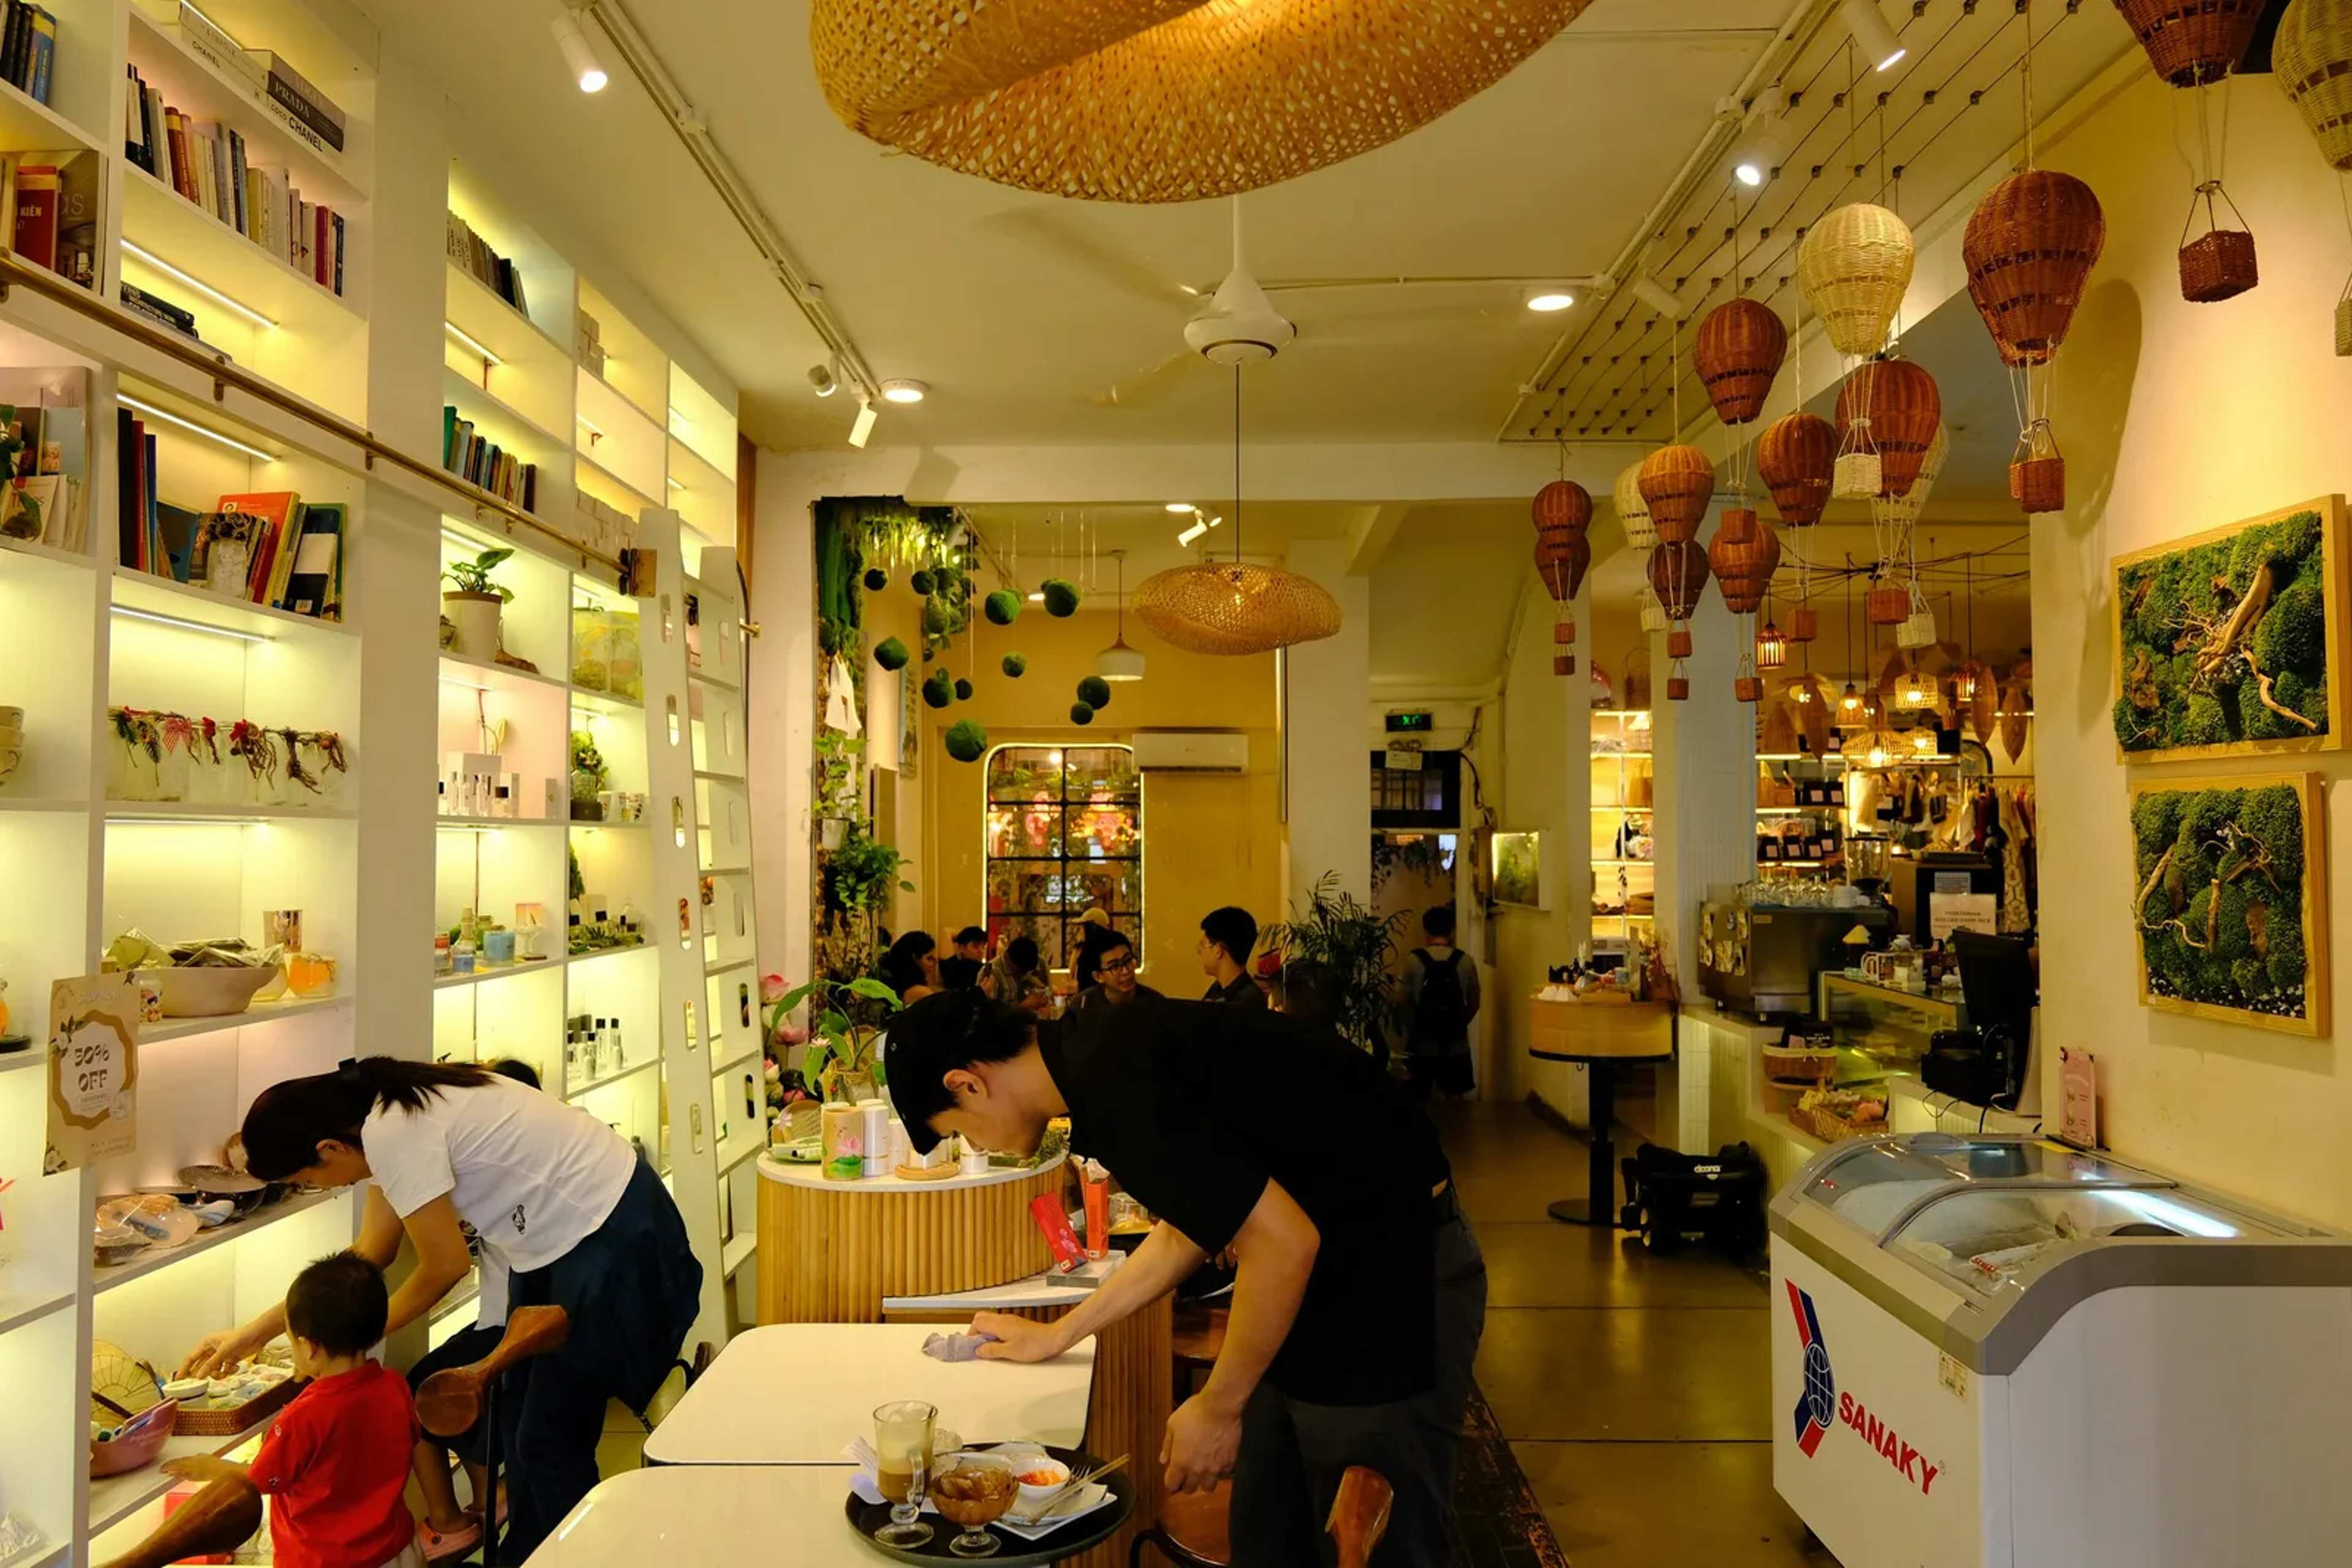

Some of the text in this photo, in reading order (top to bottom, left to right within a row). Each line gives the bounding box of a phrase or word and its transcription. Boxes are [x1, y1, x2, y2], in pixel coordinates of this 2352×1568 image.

[192, 40, 221, 69] CHANEL
[276, 81, 310, 118] PRADA
[288, 116, 323, 153] CHANEL
[74, 1043, 110, 1068] 50%
[77, 1069, 108, 1092] OFF
[1839, 1391, 1939, 1495] SANAKY
